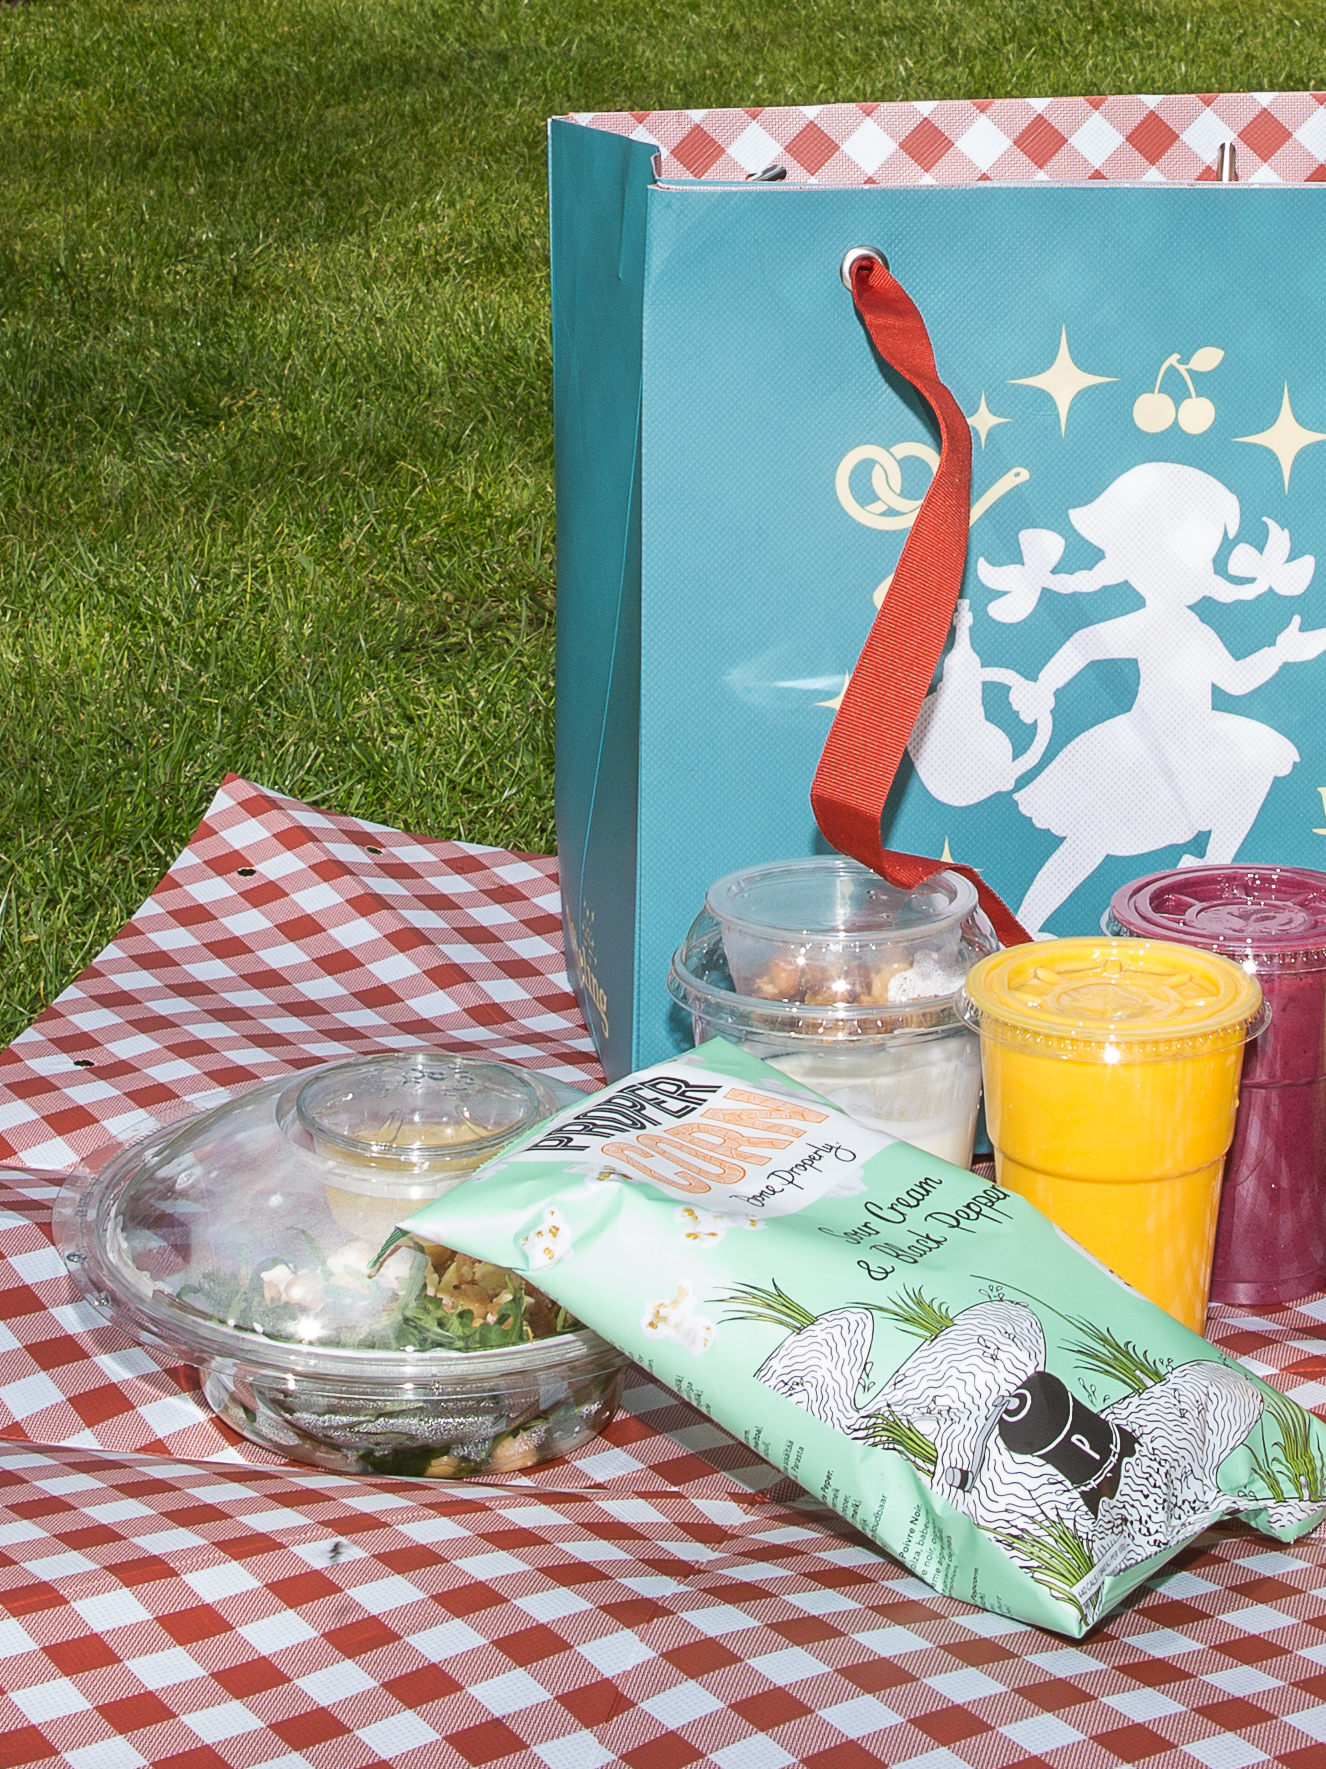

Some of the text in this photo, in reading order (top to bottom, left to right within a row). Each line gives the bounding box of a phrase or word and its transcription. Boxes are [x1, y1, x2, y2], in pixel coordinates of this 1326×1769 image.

[524, 1076, 723, 1152] PROPER
[600, 1087, 830, 1195] CORN
[729, 1183, 785, 1208] Done
[817, 1174, 943, 1245] Sour Cream
[856, 1182, 1014, 1281] & Black Pepper
[1071, 1433, 1101, 1460] P
[898, 1527, 916, 1560] Poivre
